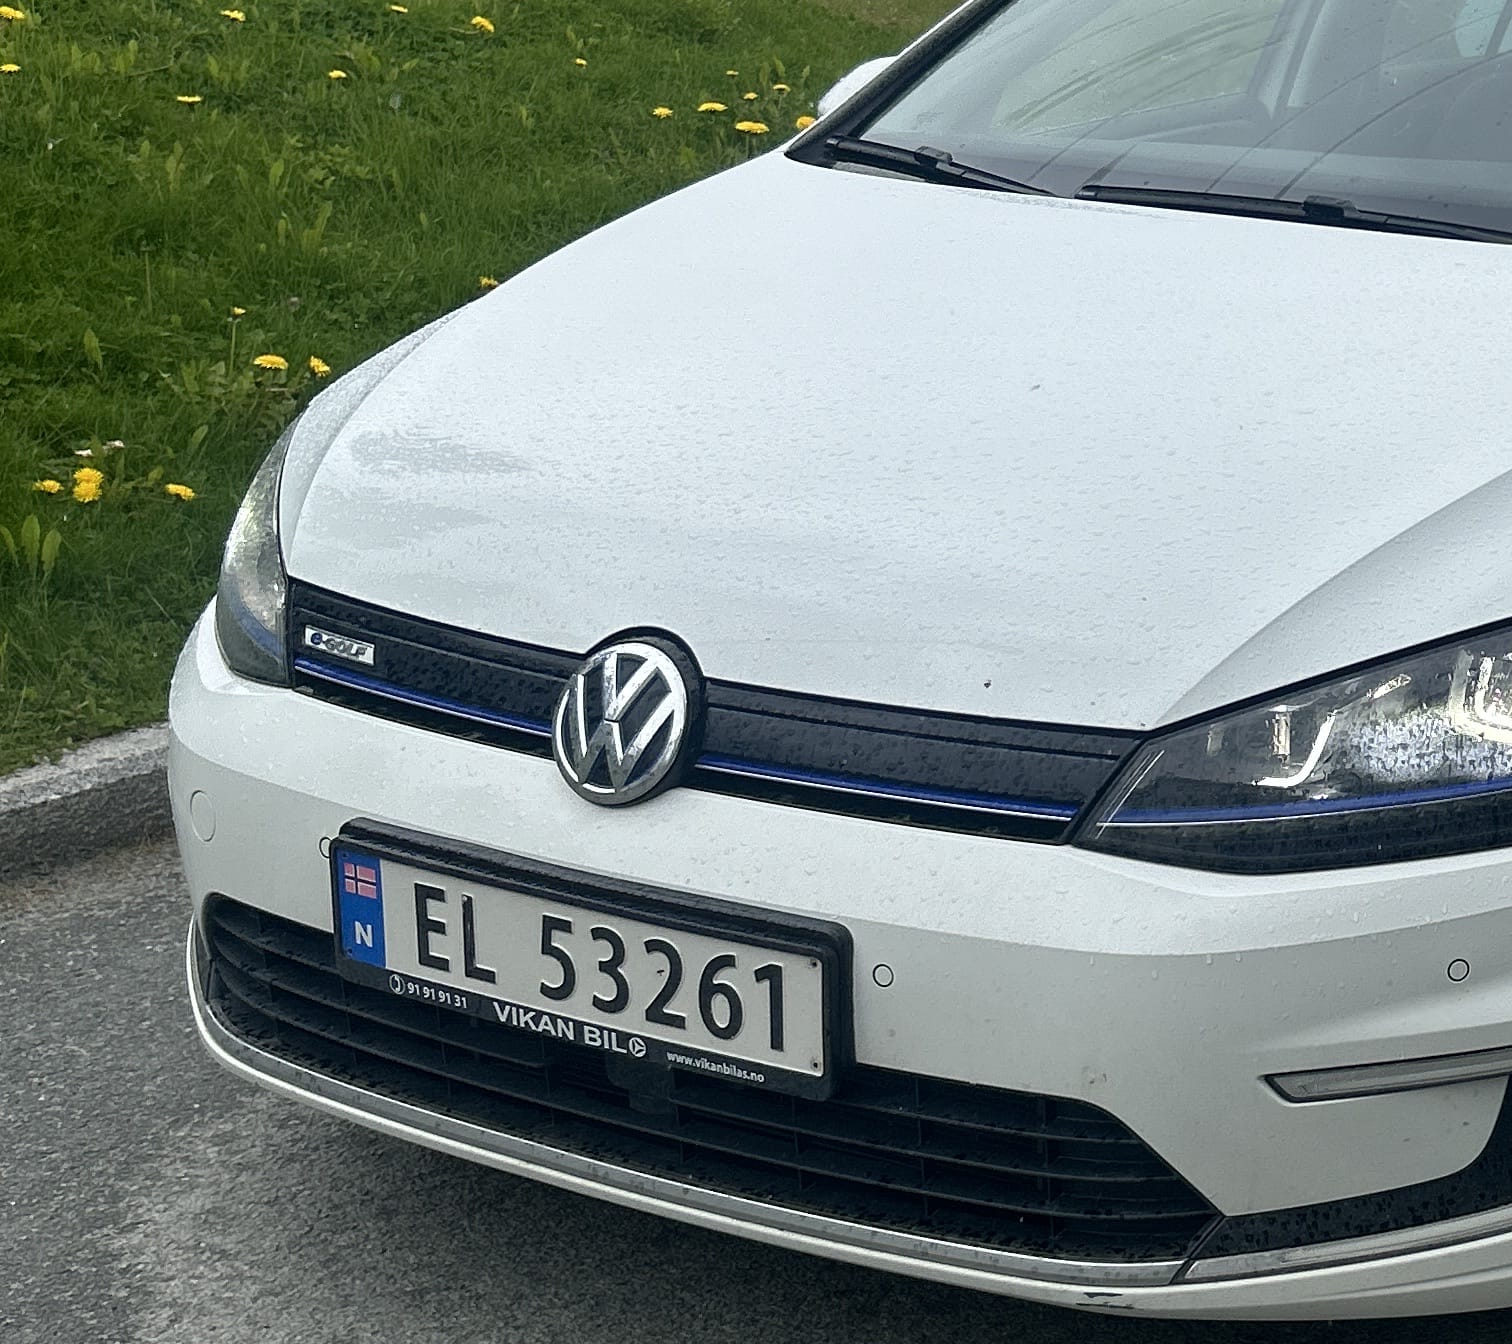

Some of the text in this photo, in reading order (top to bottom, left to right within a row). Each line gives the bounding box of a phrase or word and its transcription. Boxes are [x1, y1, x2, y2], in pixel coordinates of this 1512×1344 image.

[354, 920, 374, 948] N
[414, 882, 784, 1053] EL 53261
[407, 982, 467, 1008] 91 91 91 31
[493, 1001, 576, 1041] VIKAN
[666, 1051, 765, 1084] www.vikanbilas.no
